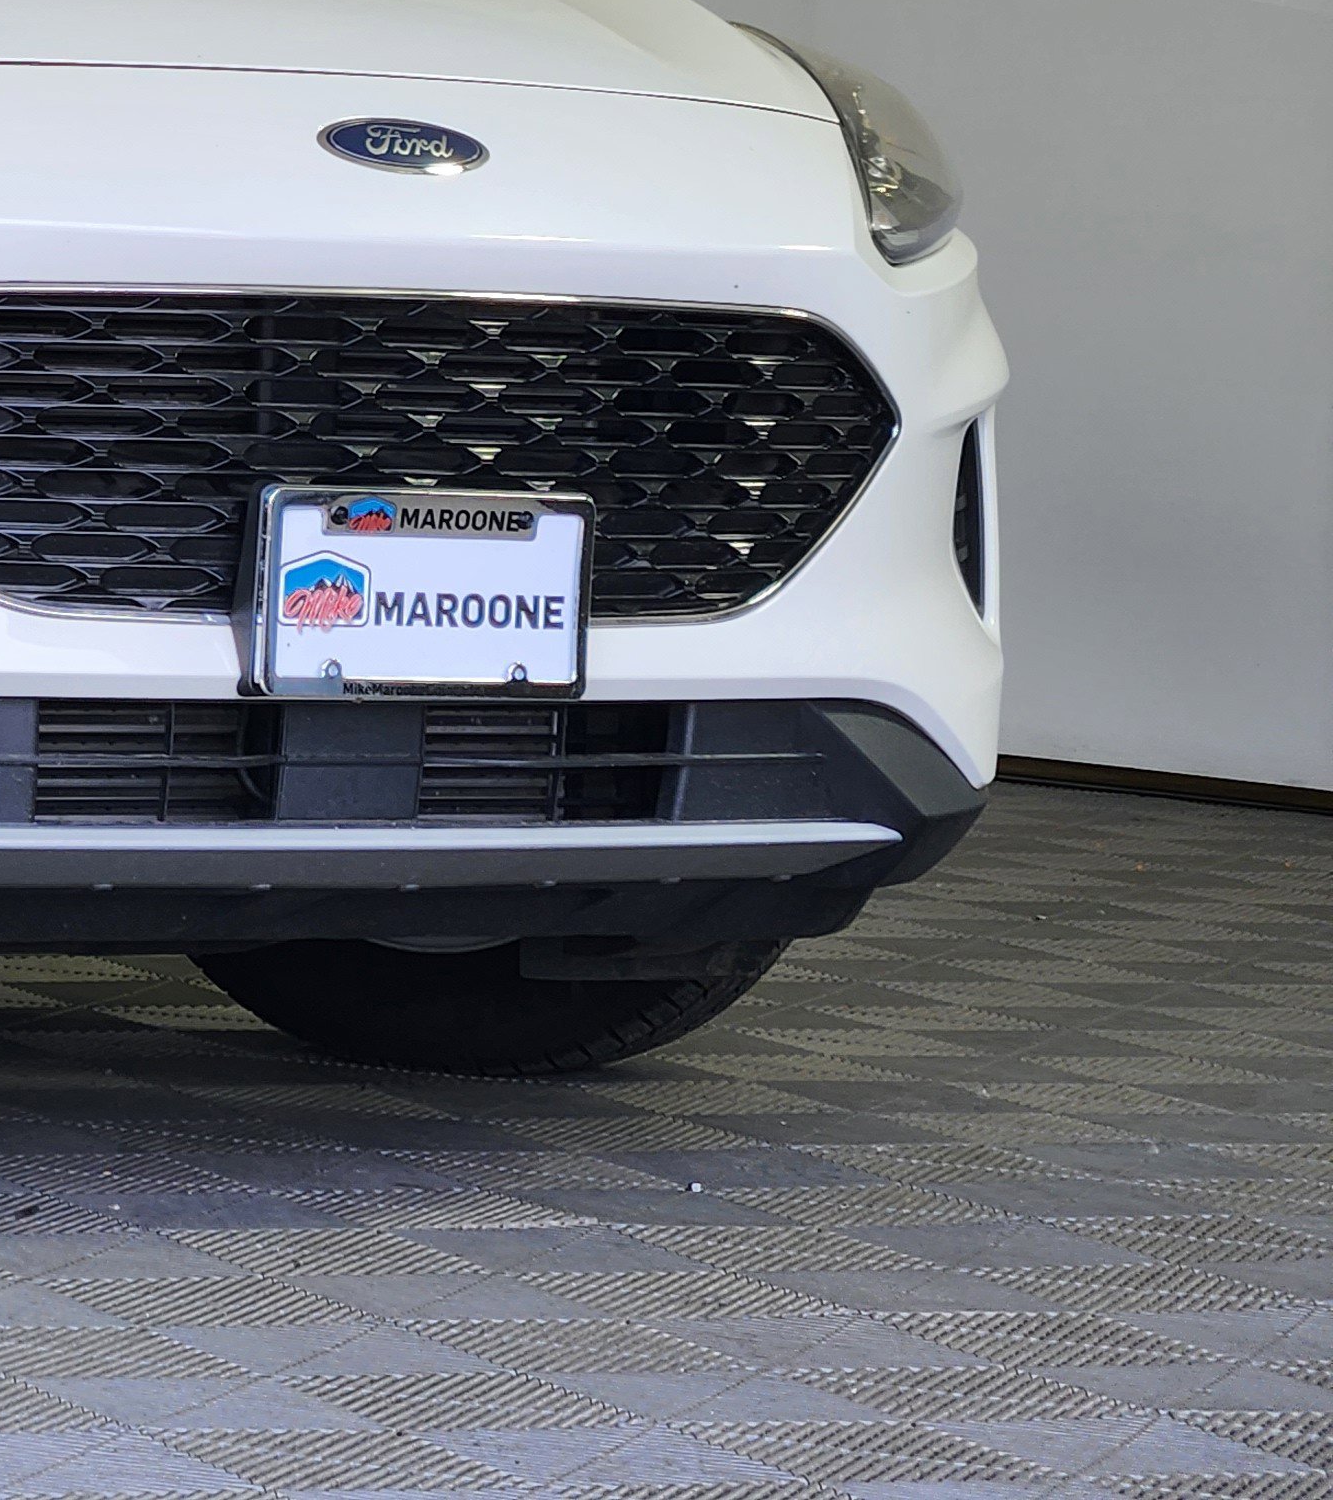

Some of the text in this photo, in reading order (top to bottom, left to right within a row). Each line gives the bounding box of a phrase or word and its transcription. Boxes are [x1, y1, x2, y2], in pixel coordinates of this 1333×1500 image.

[365, 124, 455, 159] Ford
[400, 508, 521, 533] MAROONE
[284, 584, 365, 636] Mike
[374, 591, 565, 630] MAROONE
